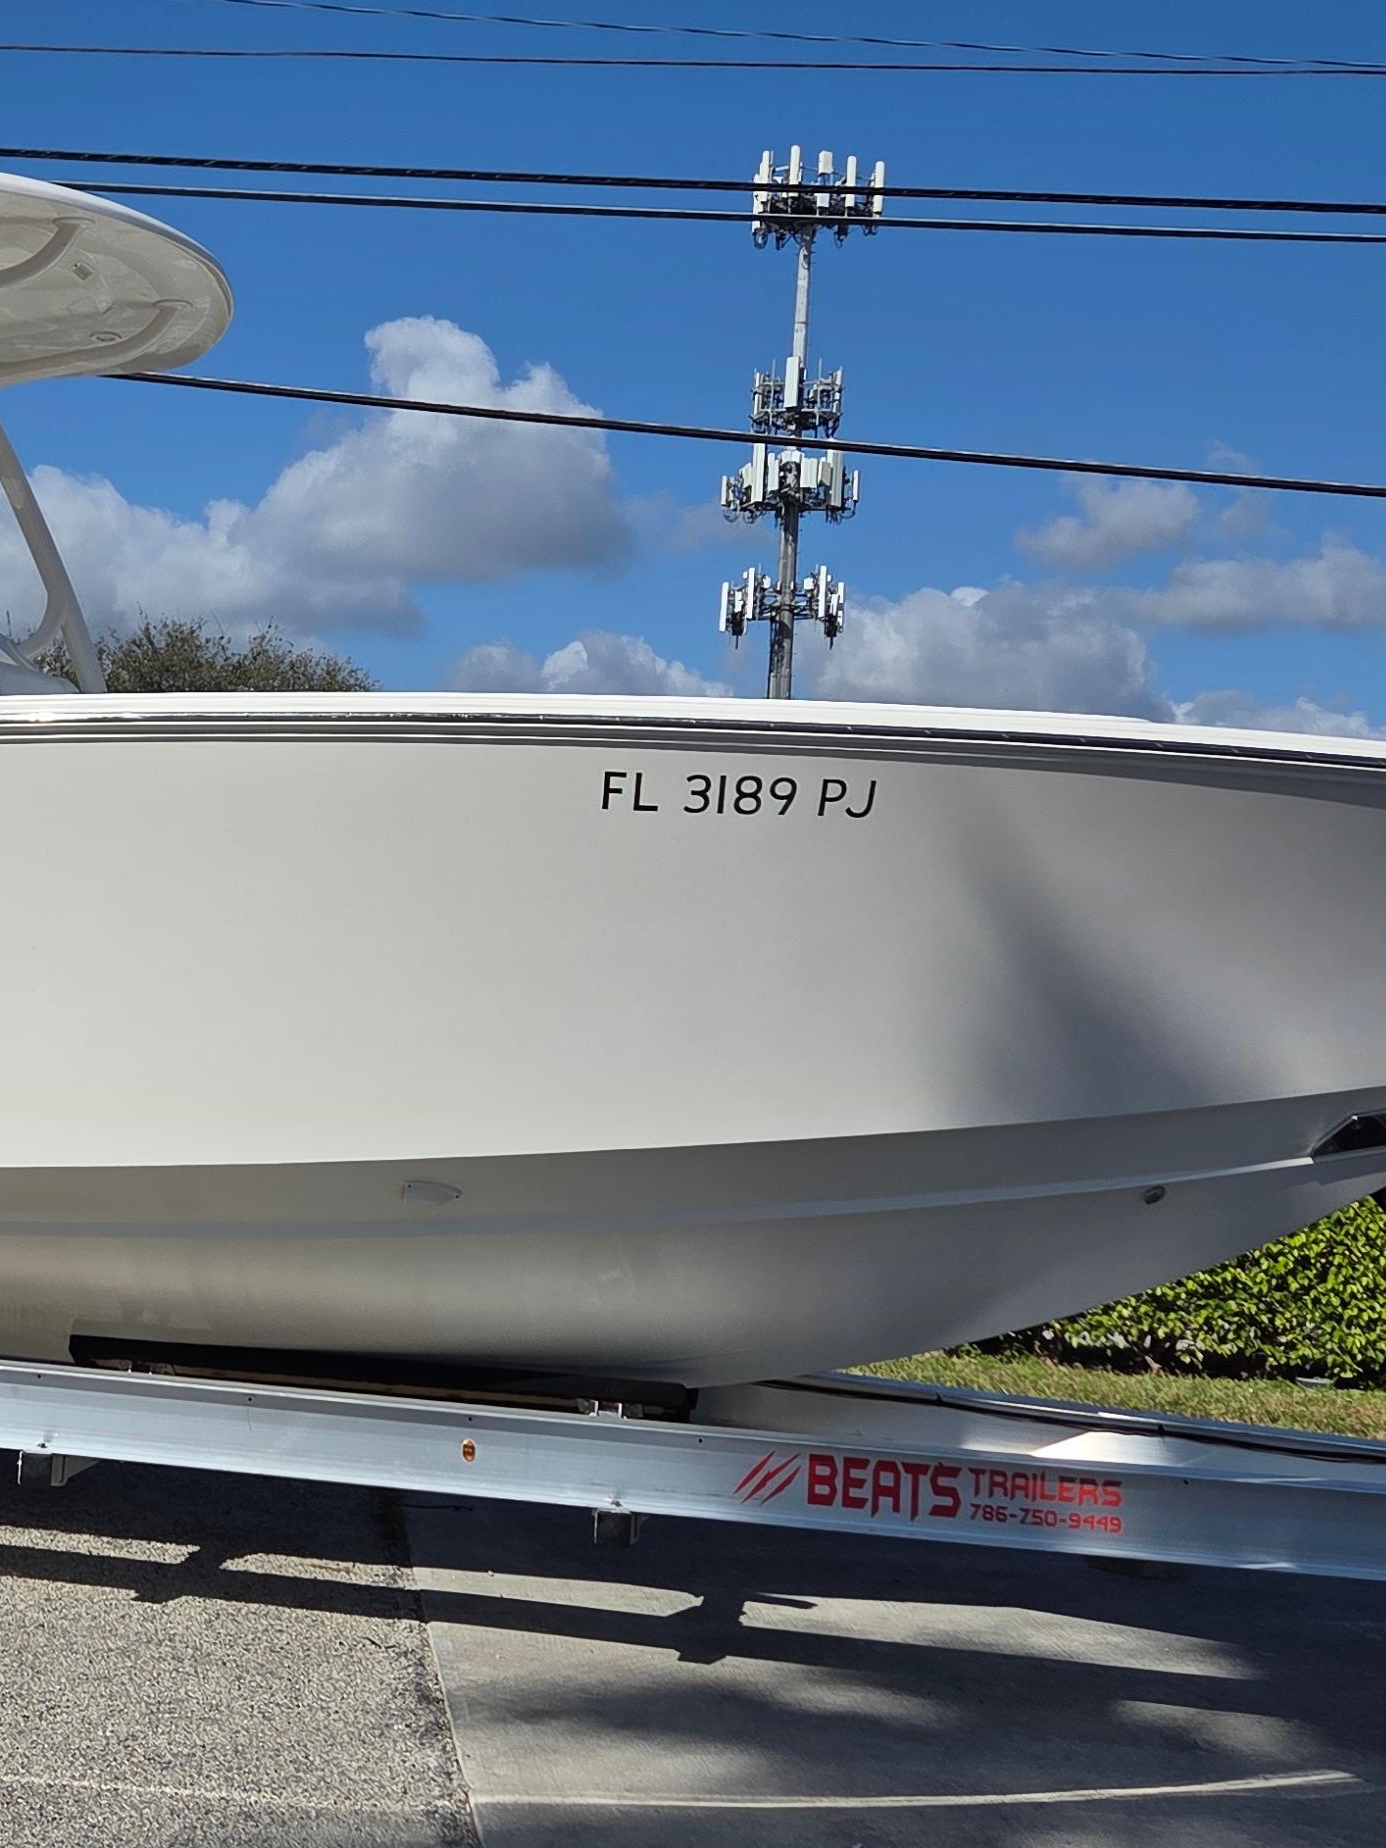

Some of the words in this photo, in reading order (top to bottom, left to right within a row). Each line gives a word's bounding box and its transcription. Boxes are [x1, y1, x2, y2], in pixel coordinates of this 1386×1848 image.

[601, 771, 658, 812] FL
[683, 774, 797, 815] 3189
[817, 778, 877, 818] PJ
[807, 1453, 962, 1522] BEATS
[968, 1467, 1123, 1507] TRAILERS
[970, 1503, 1122, 1532] 786-750-9449
